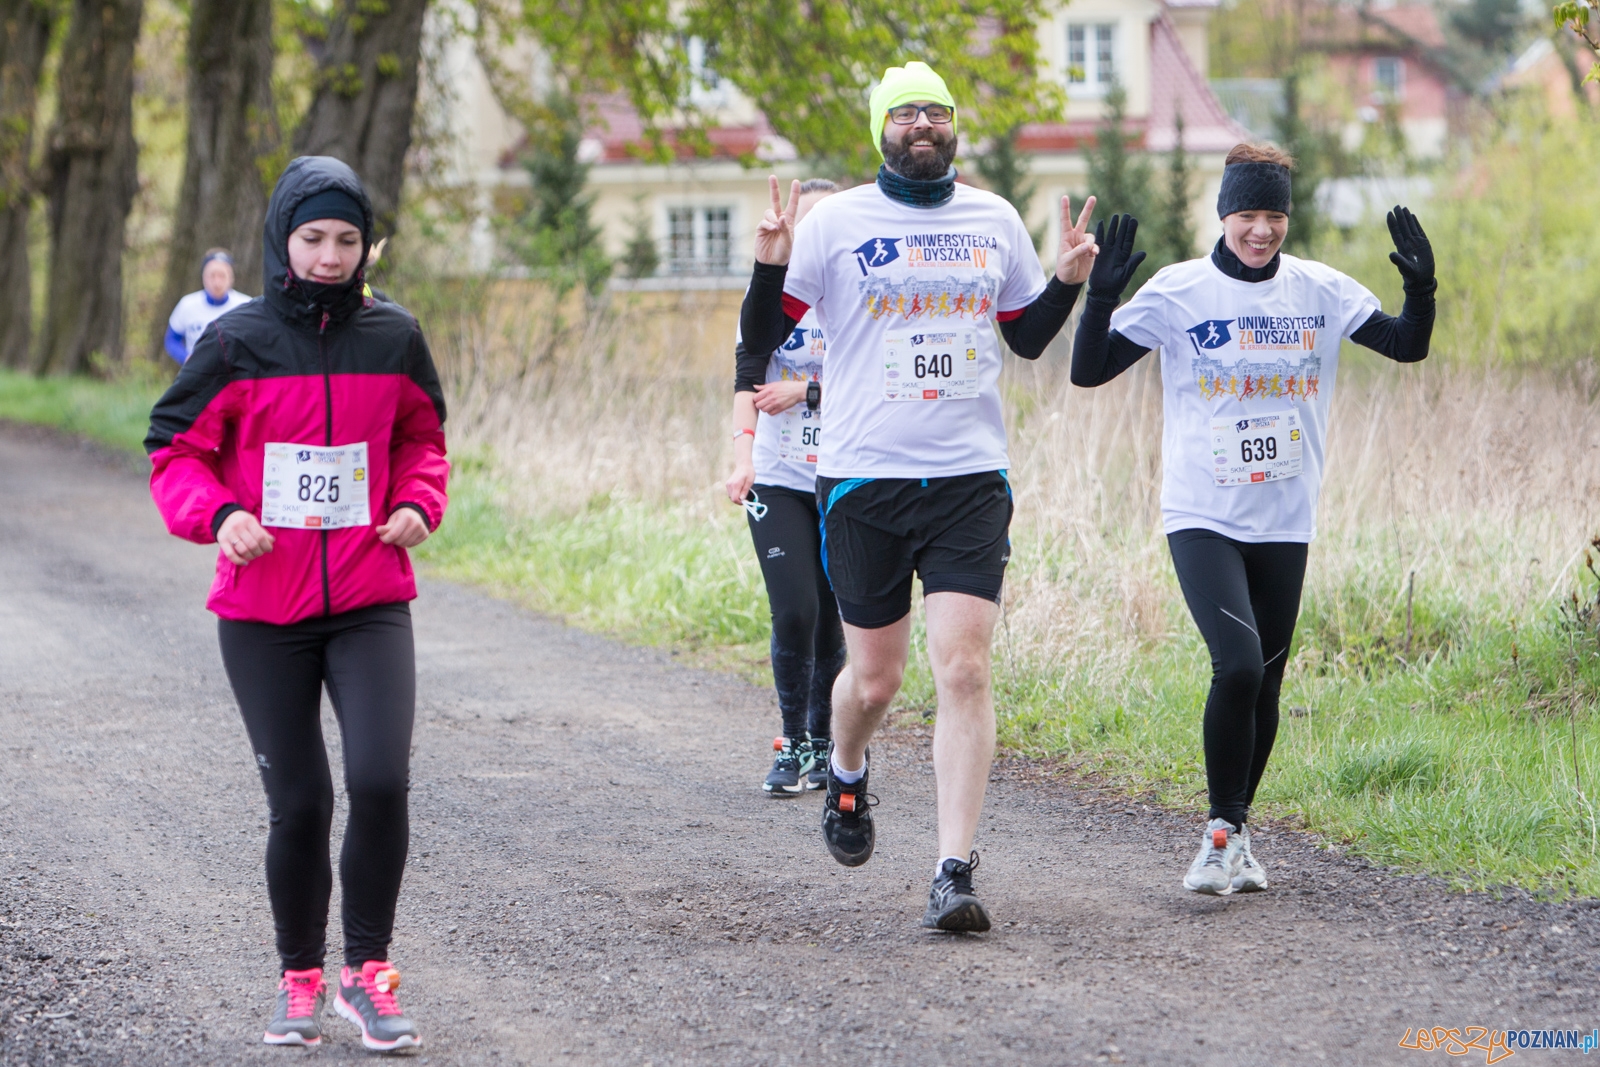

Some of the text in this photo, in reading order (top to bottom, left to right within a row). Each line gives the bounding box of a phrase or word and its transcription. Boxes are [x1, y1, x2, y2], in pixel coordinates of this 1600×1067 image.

[906, 234, 997, 250] UNIWERSYTECKA
[907, 248, 986, 268] ZADYSZKA IV
[1238, 315, 1325, 329] UNIWERSYTECKA
[1239, 330, 1316, 350] ZADYSZKA IV
[915, 354, 952, 378] 640
[1241, 436, 1277, 463] 639
[298, 474, 339, 503] 825
